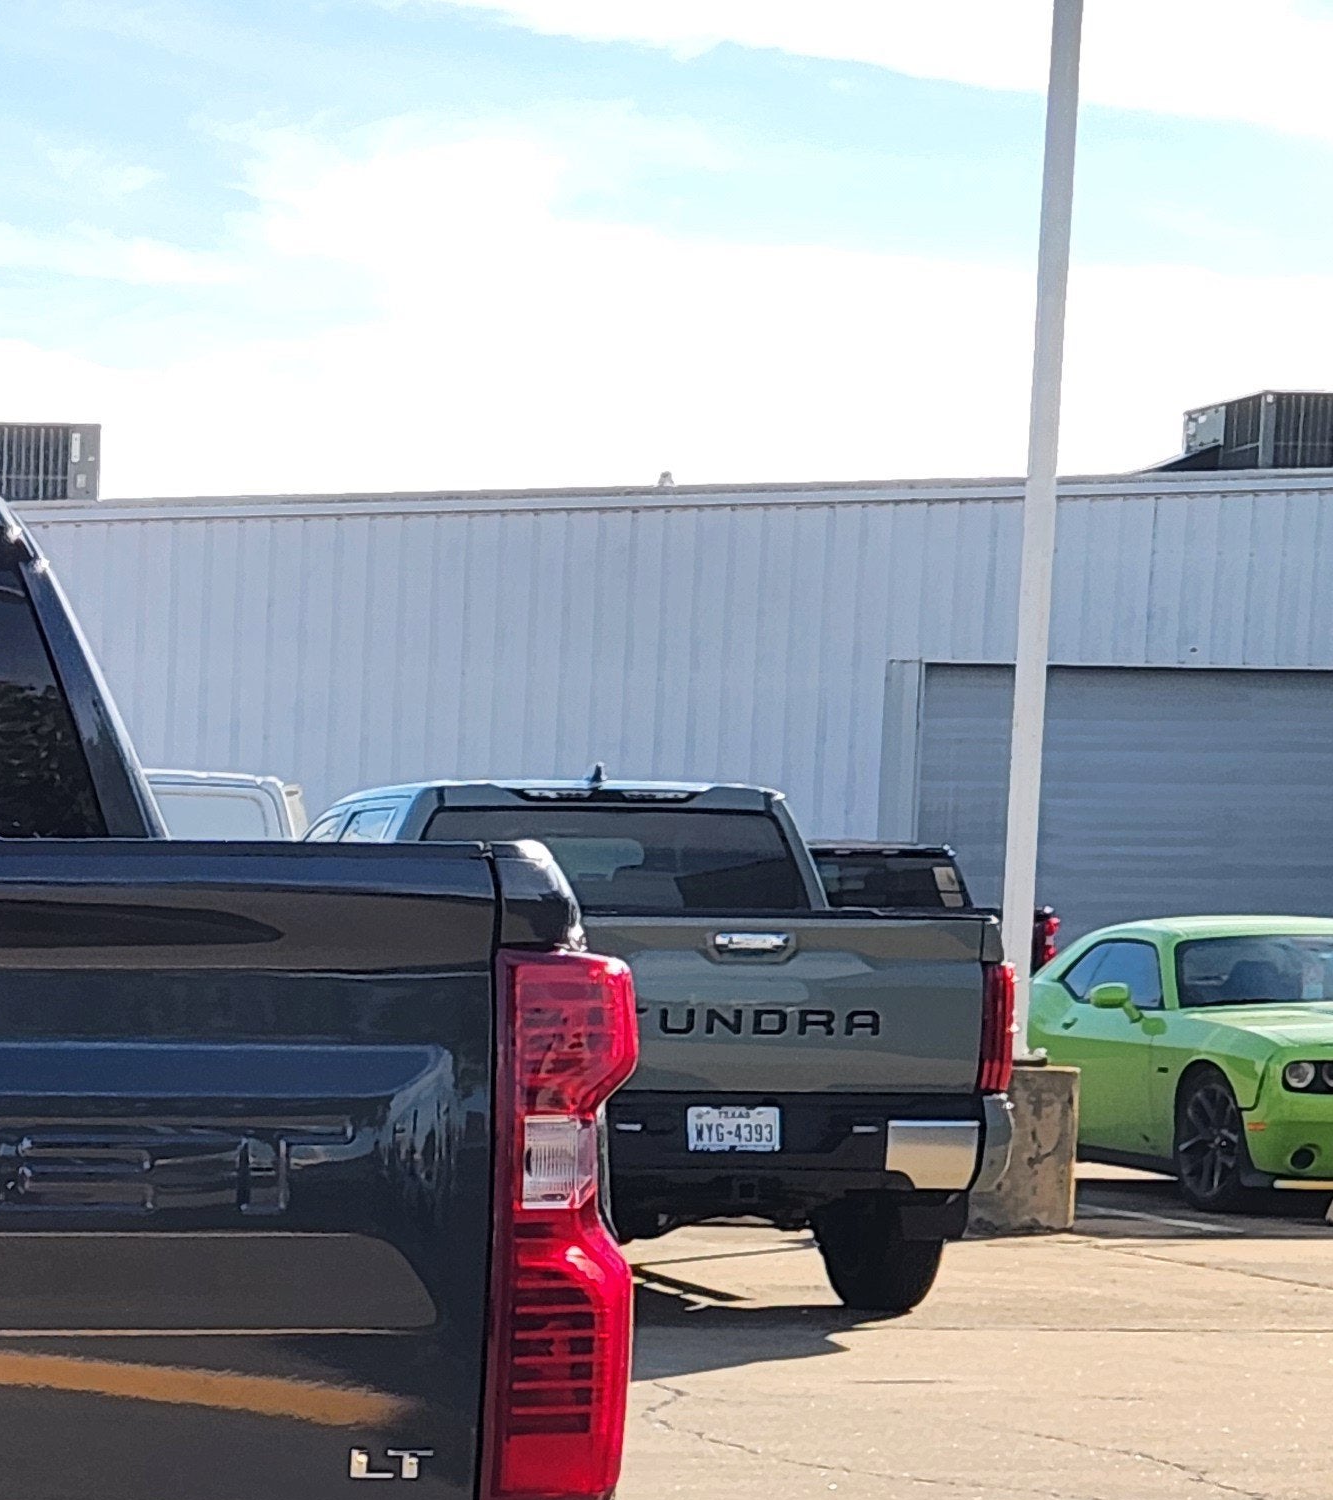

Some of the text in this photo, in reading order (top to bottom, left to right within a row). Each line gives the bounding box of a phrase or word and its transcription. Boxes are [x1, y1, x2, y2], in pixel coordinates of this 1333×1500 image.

[636, 1007, 880, 1036] UNDRA
[694, 1122, 773, 1143] WYG-4393
[349, 1447, 435, 1480] LT
